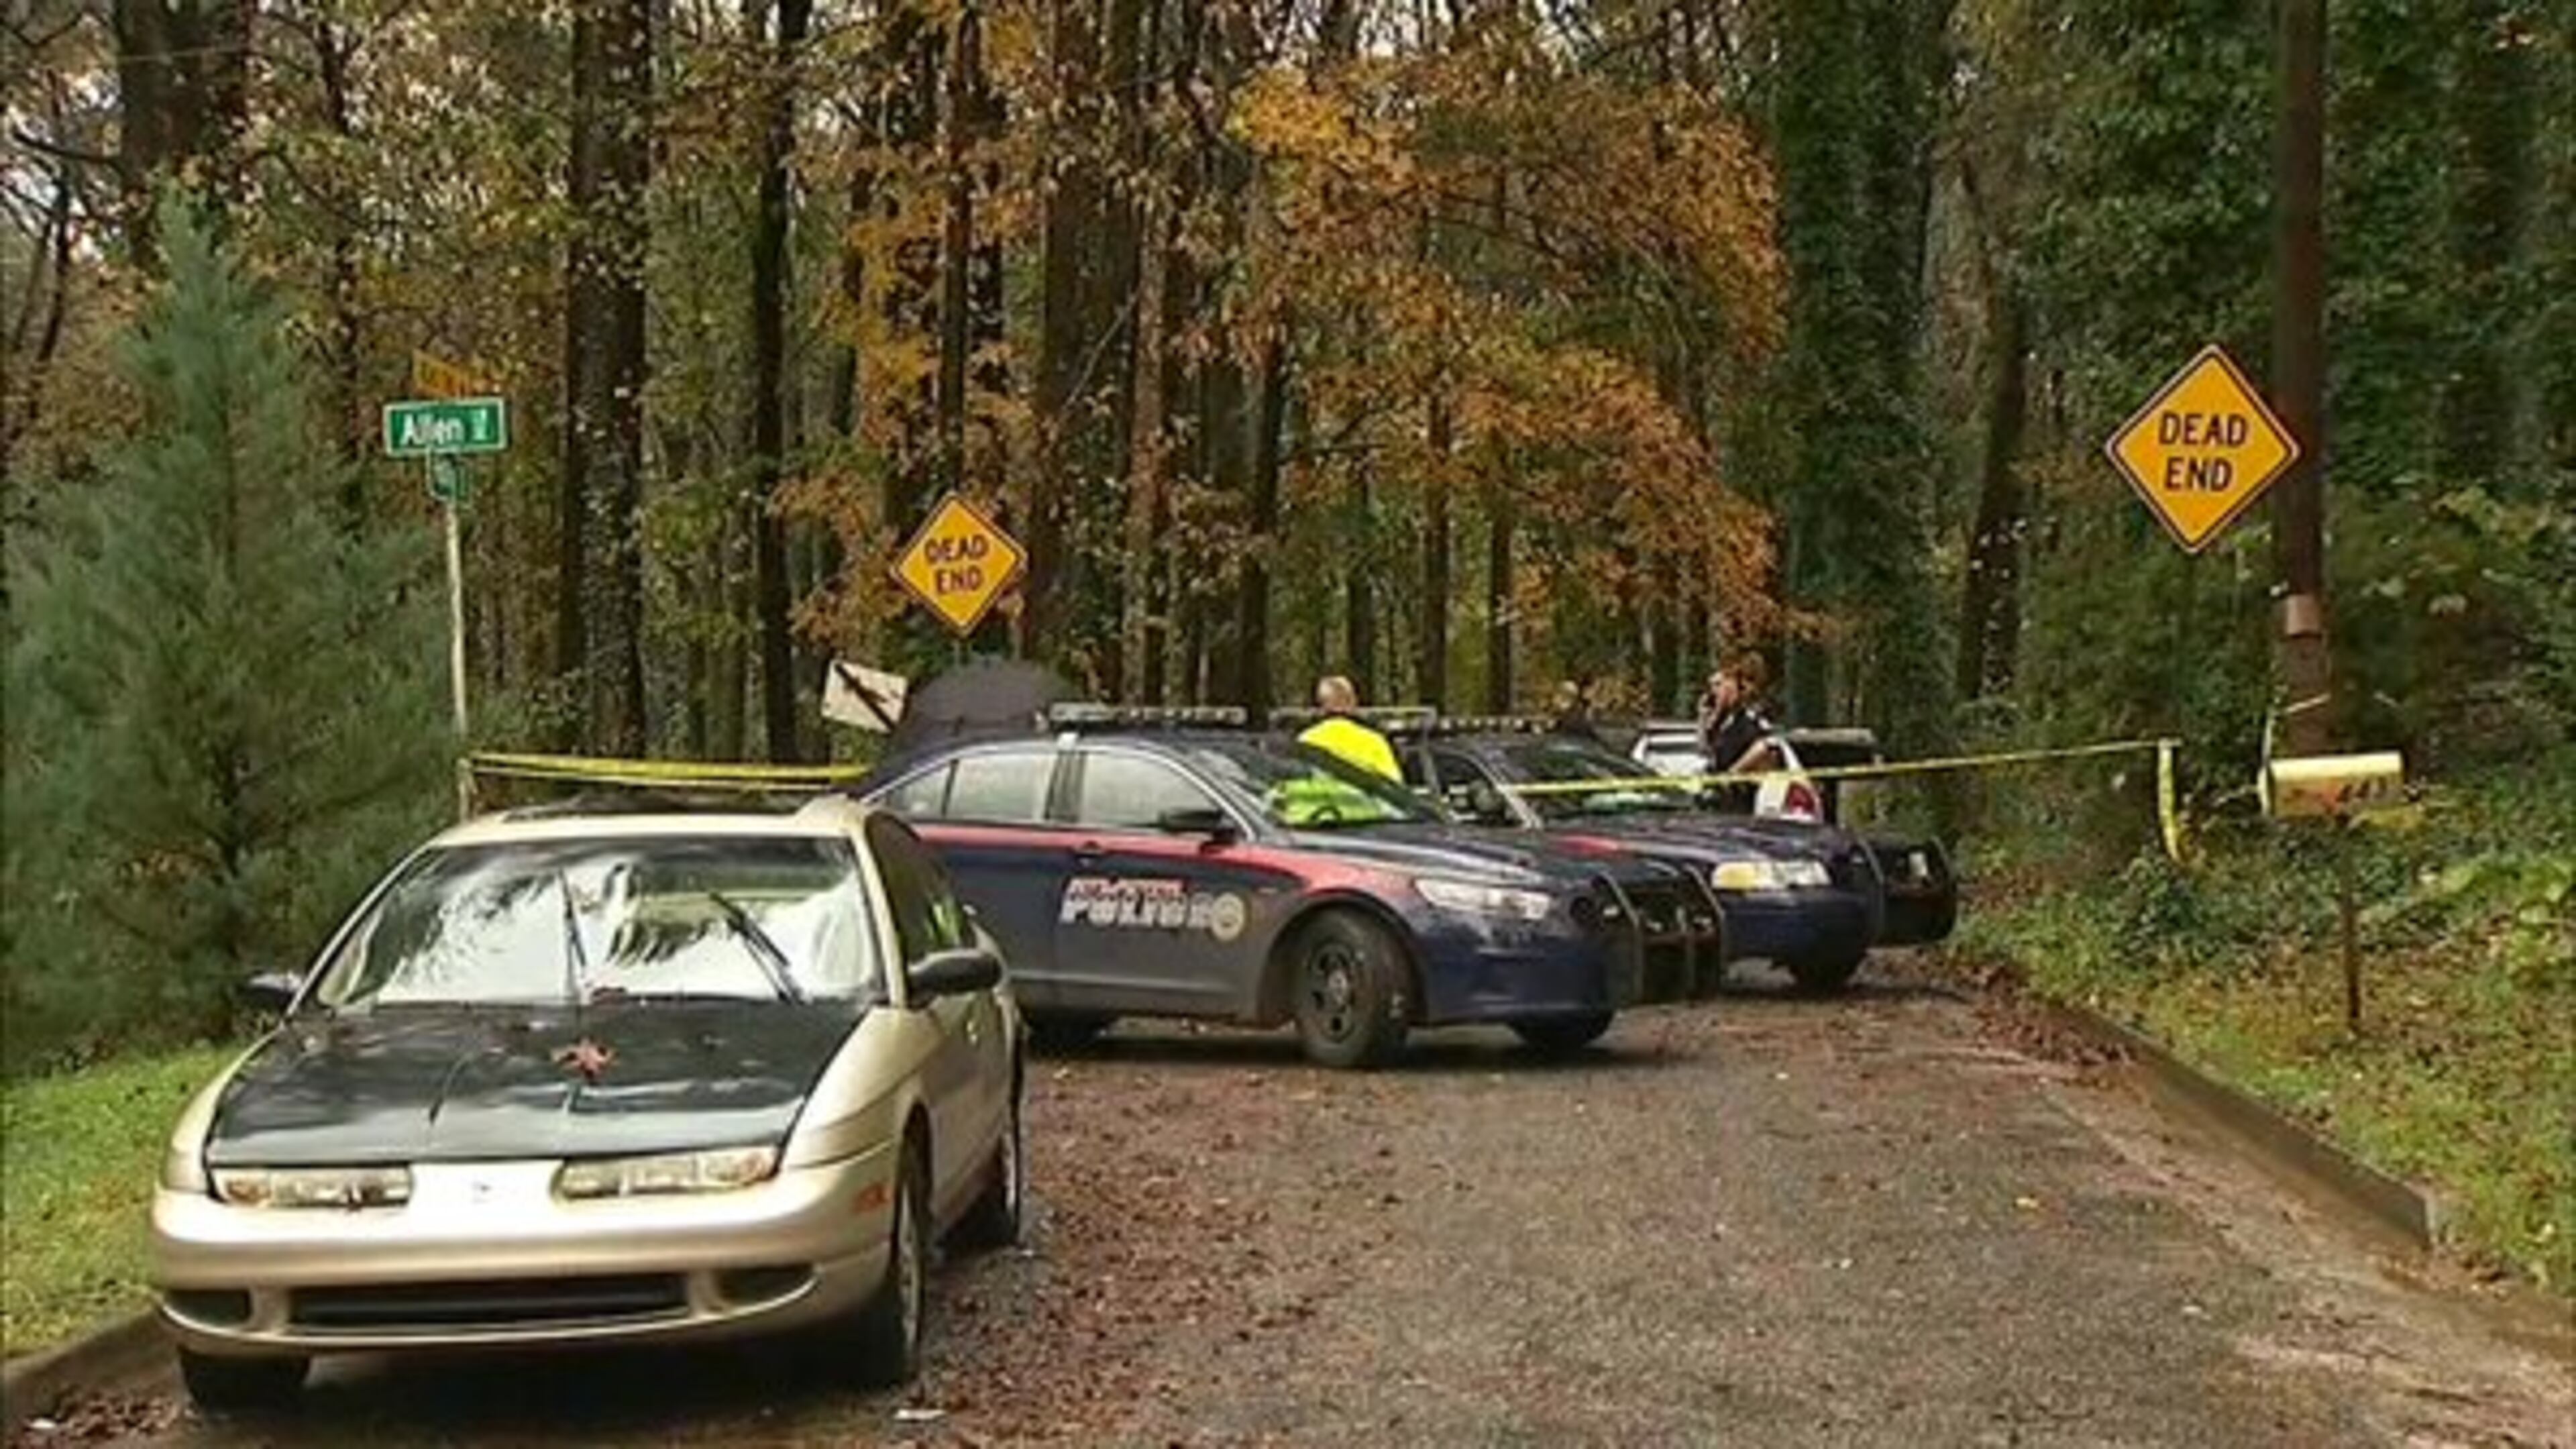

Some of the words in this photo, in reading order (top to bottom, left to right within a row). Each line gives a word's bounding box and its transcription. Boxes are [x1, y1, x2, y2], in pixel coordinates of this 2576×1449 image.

[400, 413, 464, 445] Allen
[2157, 411, 2247, 447] DEAD
[2163, 456, 2233, 492] END
[924, 534, 989, 565] DEAD
[933, 565, 984, 594] END
